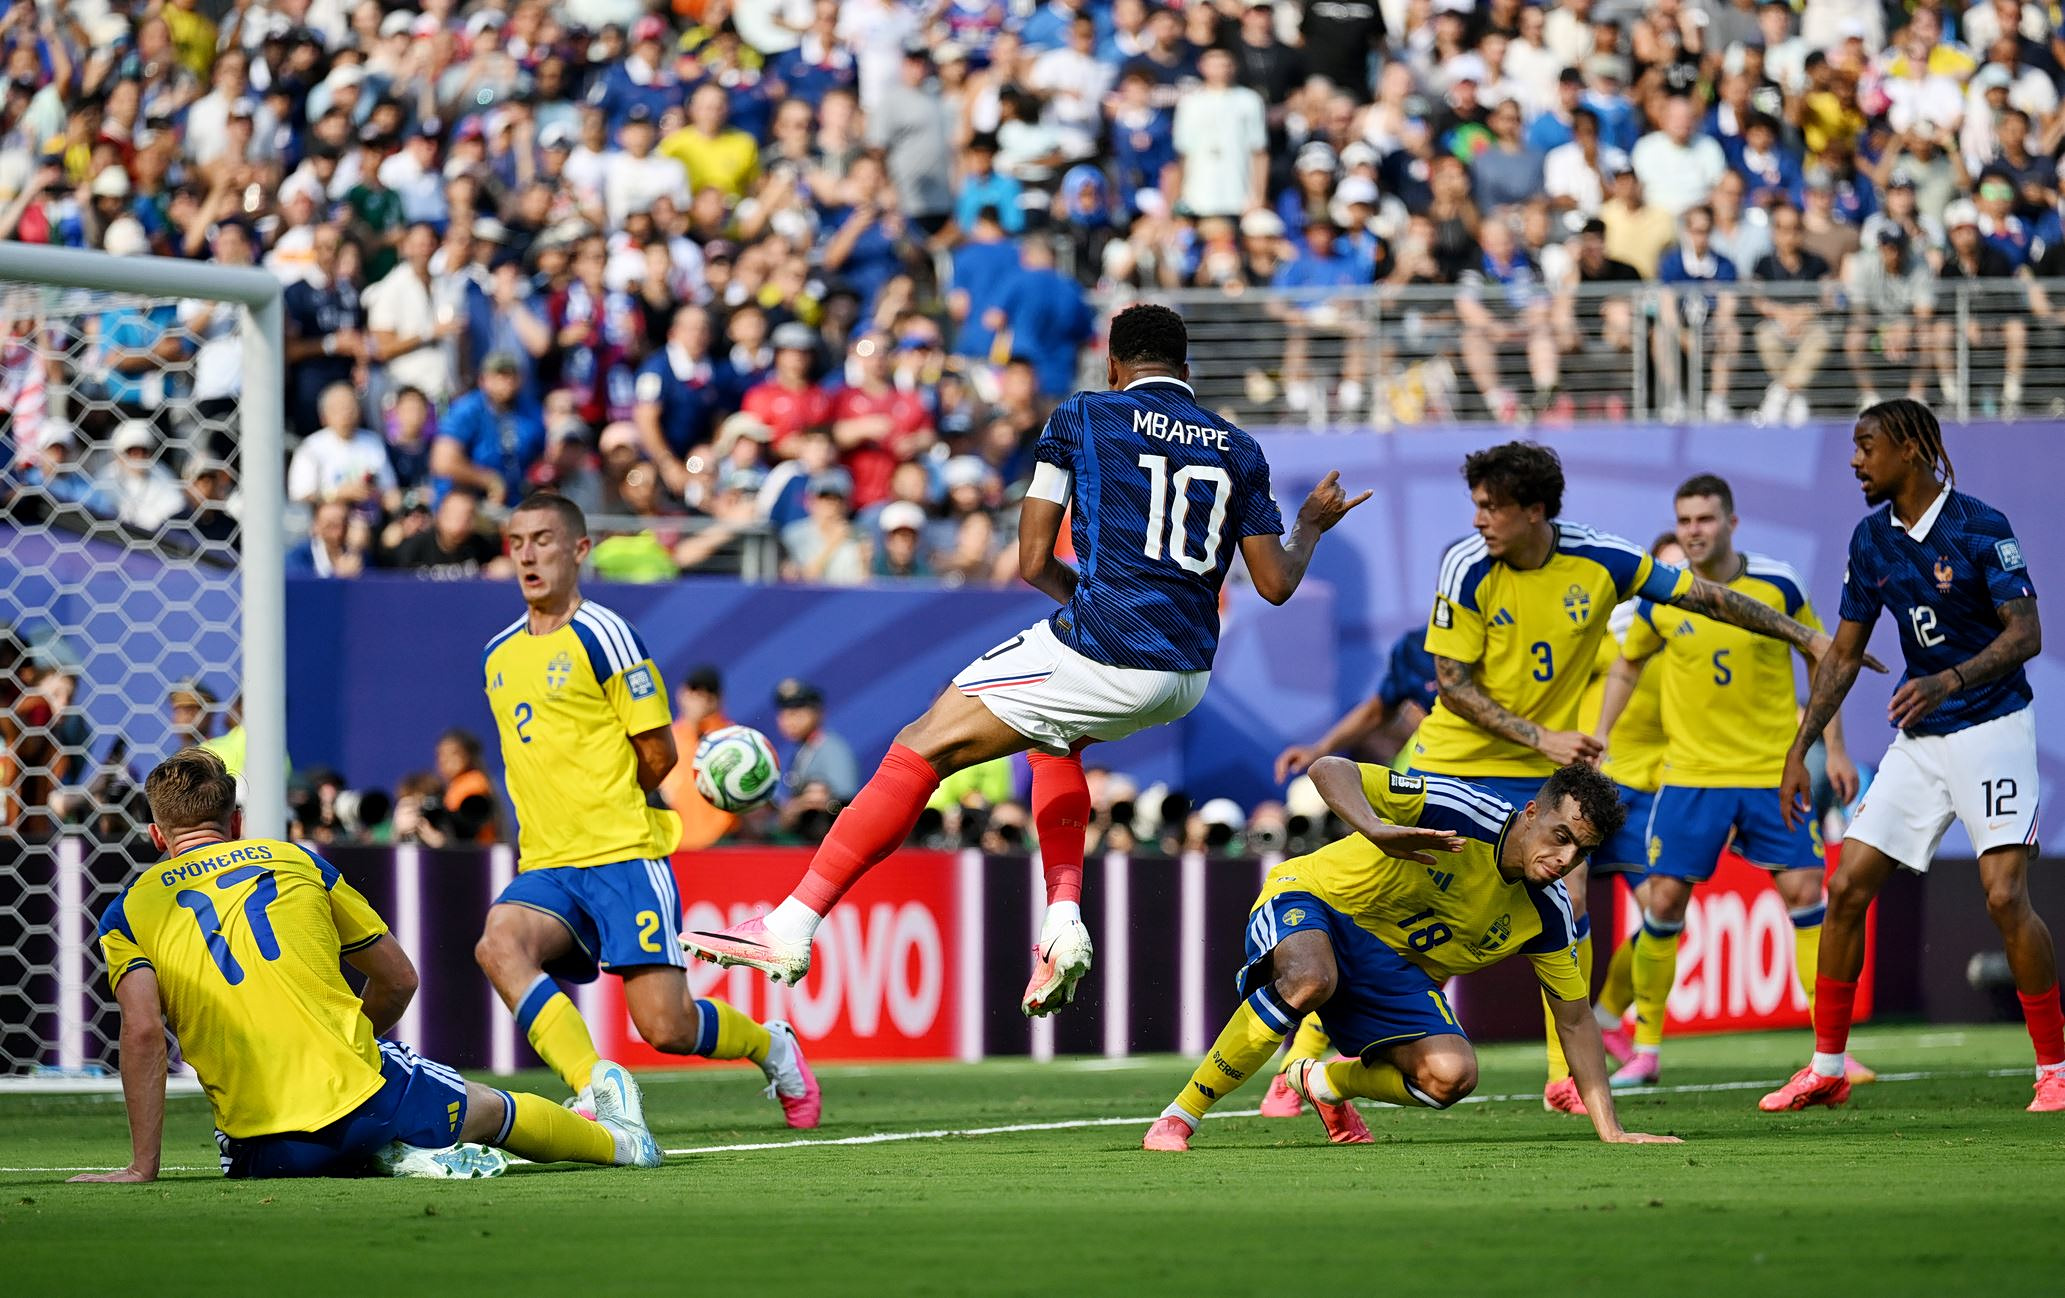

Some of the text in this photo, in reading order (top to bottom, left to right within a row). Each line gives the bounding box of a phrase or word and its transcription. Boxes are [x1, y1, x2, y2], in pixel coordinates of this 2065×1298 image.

[1133, 410, 1230, 451] MBAPPE
[1138, 454, 1232, 576] 10
[1909, 606, 1946, 648] 12
[1531, 641, 1554, 682] 3
[1713, 648, 1732, 686] 5
[515, 702, 533, 743] 2
[1981, 778, 2018, 818] 12
[161, 846, 273, 887] GYÖKERES
[176, 865, 282, 986] 17
[635, 910, 663, 953] 2
[1397, 908, 1453, 952] 18
[616, 899, 943, 1043] enovo
[1213, 1051, 1245, 1081] SVERIGE
